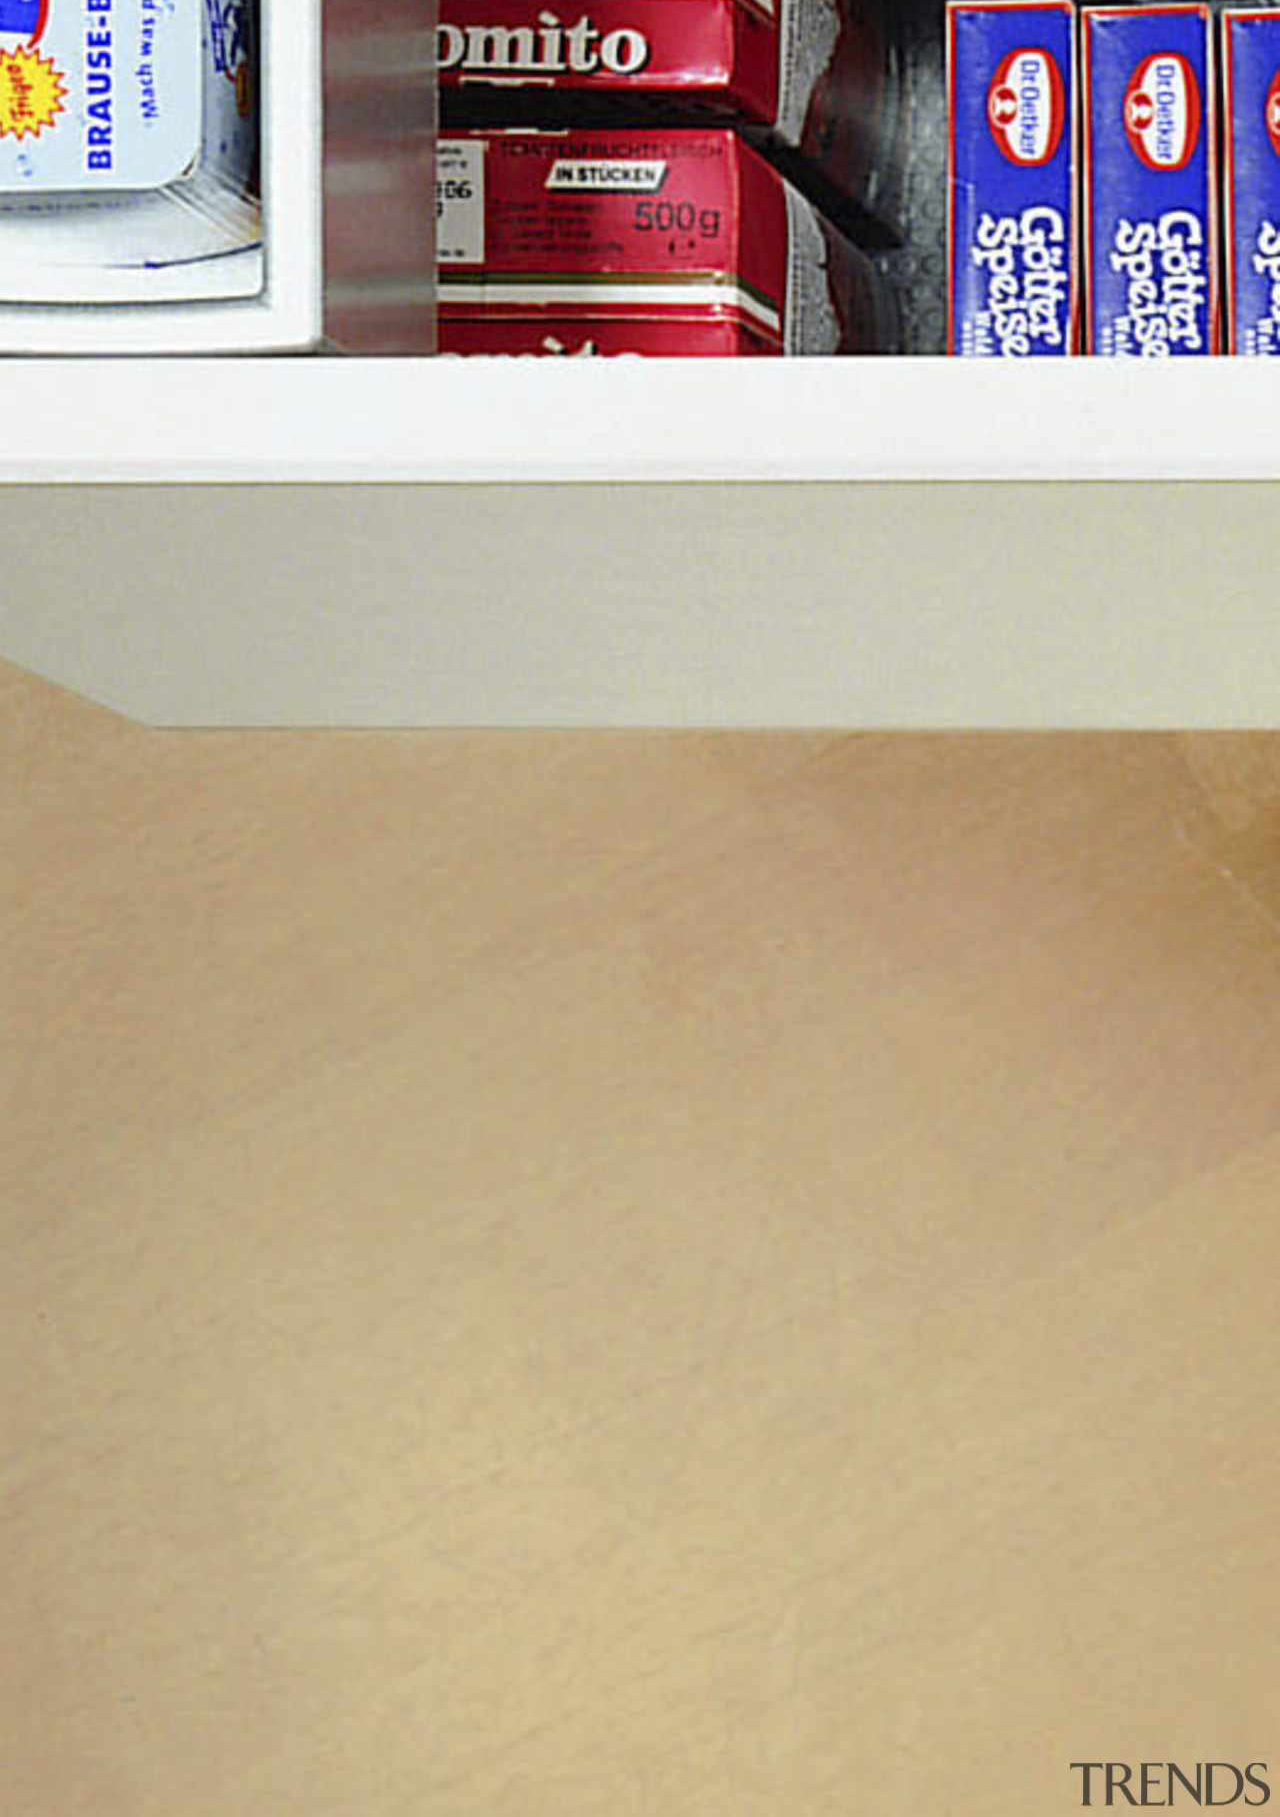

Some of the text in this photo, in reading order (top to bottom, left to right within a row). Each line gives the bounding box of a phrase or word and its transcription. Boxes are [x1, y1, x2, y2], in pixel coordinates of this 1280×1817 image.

[139, 18, 157, 57] was
[136, 63, 162, 119] Mach
[555, 164, 656, 182] IN STÜCKEN
[972, 213, 1030, 356] Speise
[1022, 206, 1067, 345] Götter
[1159, 210, 1206, 349] Götter
